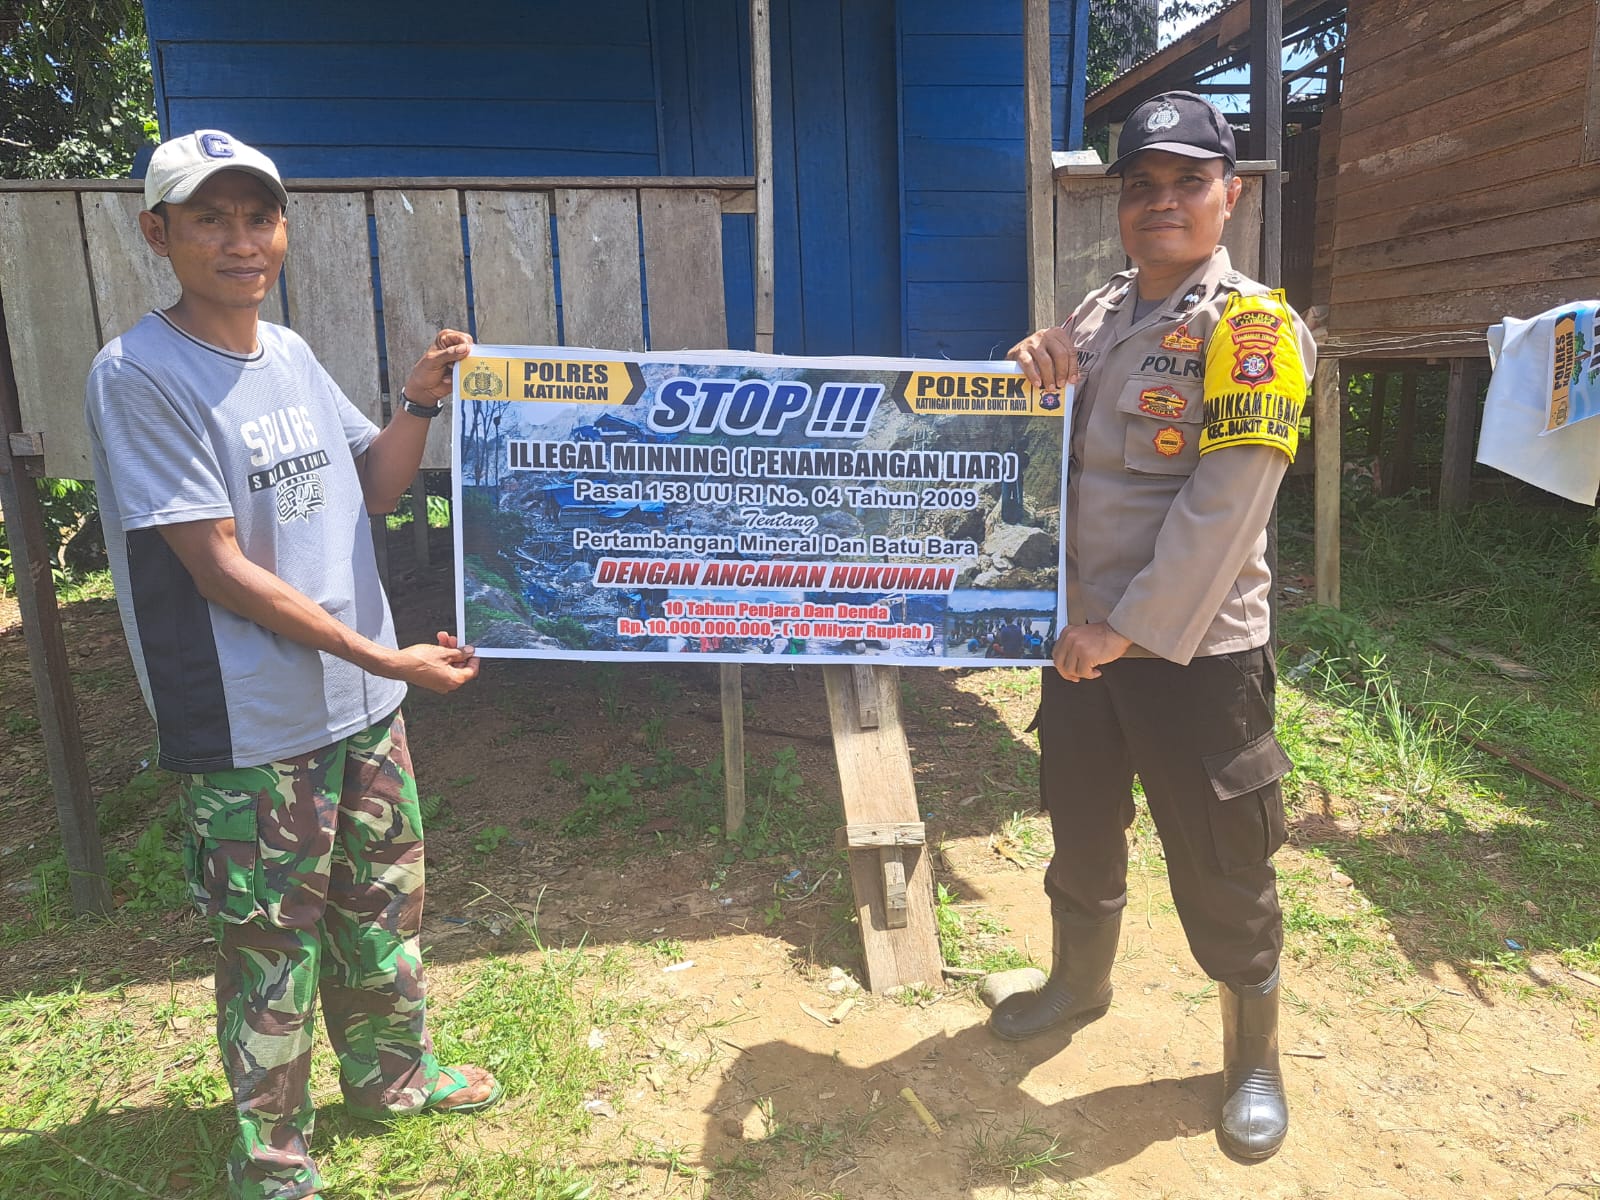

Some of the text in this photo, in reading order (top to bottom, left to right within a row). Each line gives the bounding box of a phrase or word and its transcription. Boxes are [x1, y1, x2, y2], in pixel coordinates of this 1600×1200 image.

[201, 133, 234, 158] C
[1554, 334, 1566, 390] POLRES
[1562, 331, 1573, 387] KATINGAN
[524, 361, 609, 384] POLRES
[524, 384, 609, 401] KATINGAN
[917, 375, 1026, 398] POLSEK
[653, 380, 873, 433] STOP !!!
[915, 397, 1027, 411] KATINGAN HULU DAN BUKIT RAYA
[240, 405, 318, 467] SPURS
[1266, 420, 1289, 440] RAYA
[510, 442, 604, 469] ILLEGAL
[613, 444, 728, 473] MINNING
[576, 481, 976, 507] Pasal 158 UU RI No. 04 Tahun 2009
[742, 510, 816, 533] Tentang
[576, 532, 976, 555] Pertambangan Mineral Dan Batu Bara
[597, 561, 955, 591] DENGAN ANCAMAN HUKUMAN
[665, 601, 888, 619] 10 Tahun Penjara Dan Denda
[620, 619, 645, 635] Rp.
[813, 623, 863, 639] Milyar
